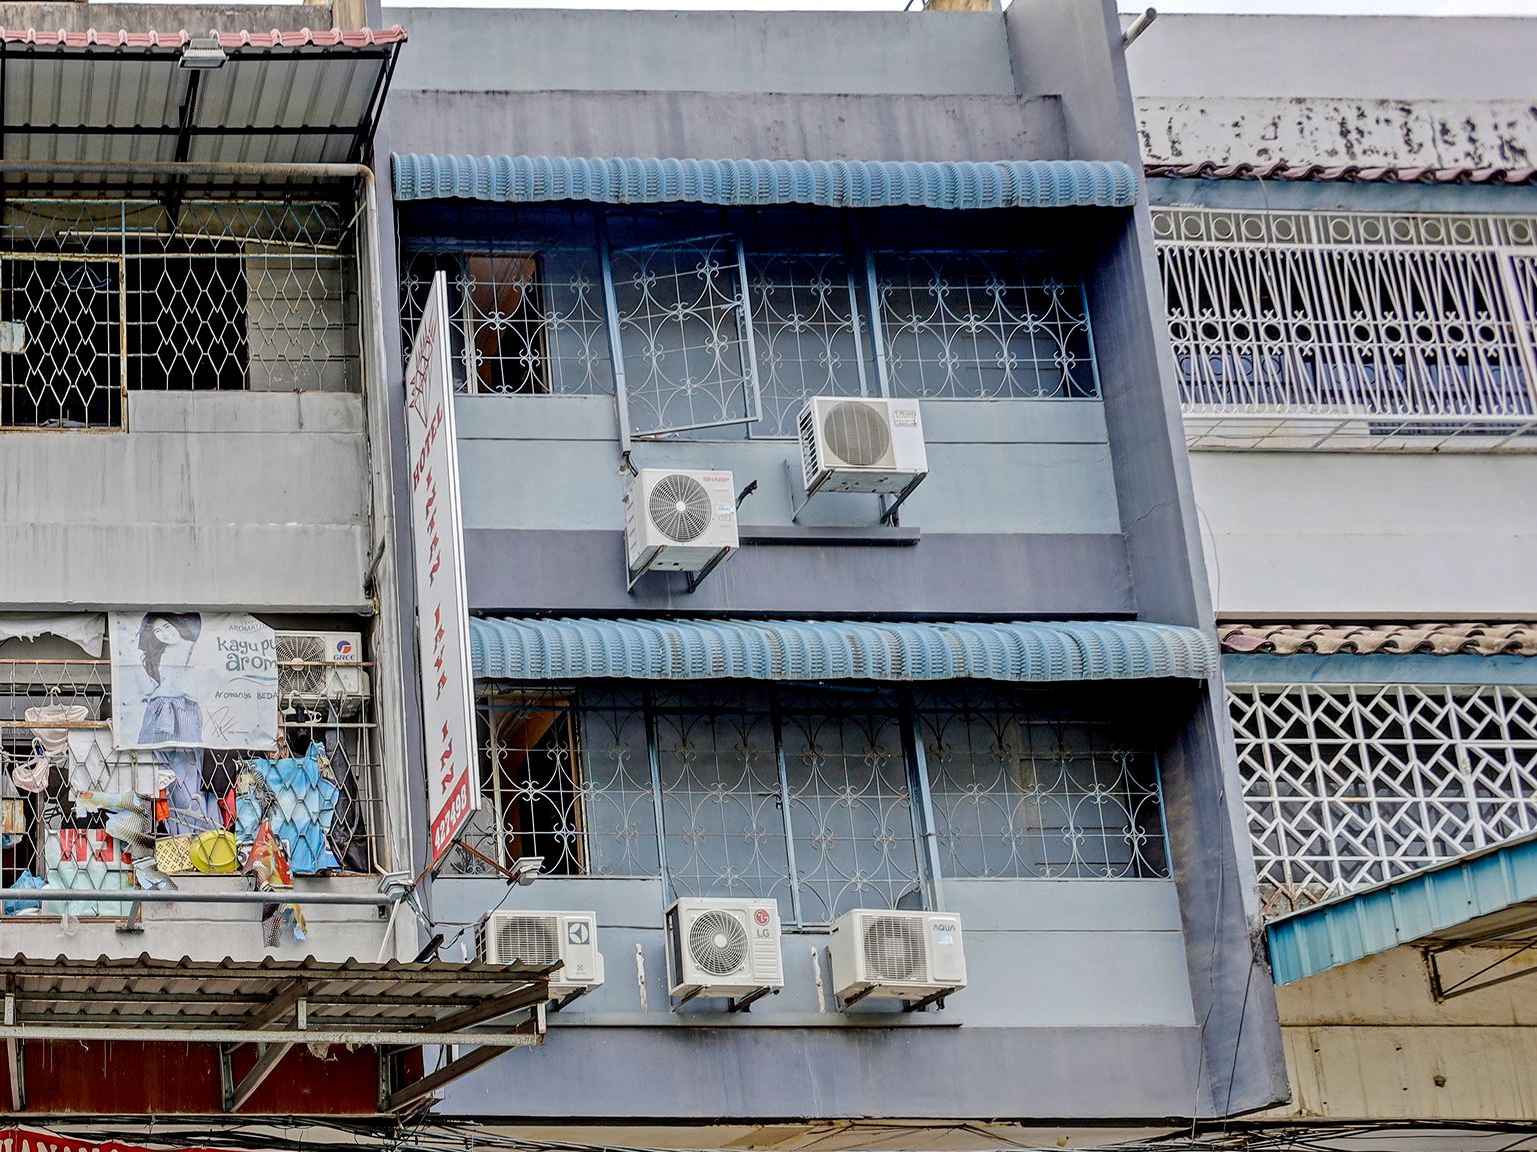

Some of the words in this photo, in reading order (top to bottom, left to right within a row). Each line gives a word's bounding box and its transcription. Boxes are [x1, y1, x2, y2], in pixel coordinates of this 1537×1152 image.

[413, 401, 443, 494] HOTEL
[217, 636, 258, 655] kayu
[215, 690, 251, 699] Aromanya
[434, 783, 467, 850] 427498
[757, 929, 770, 938] LG
